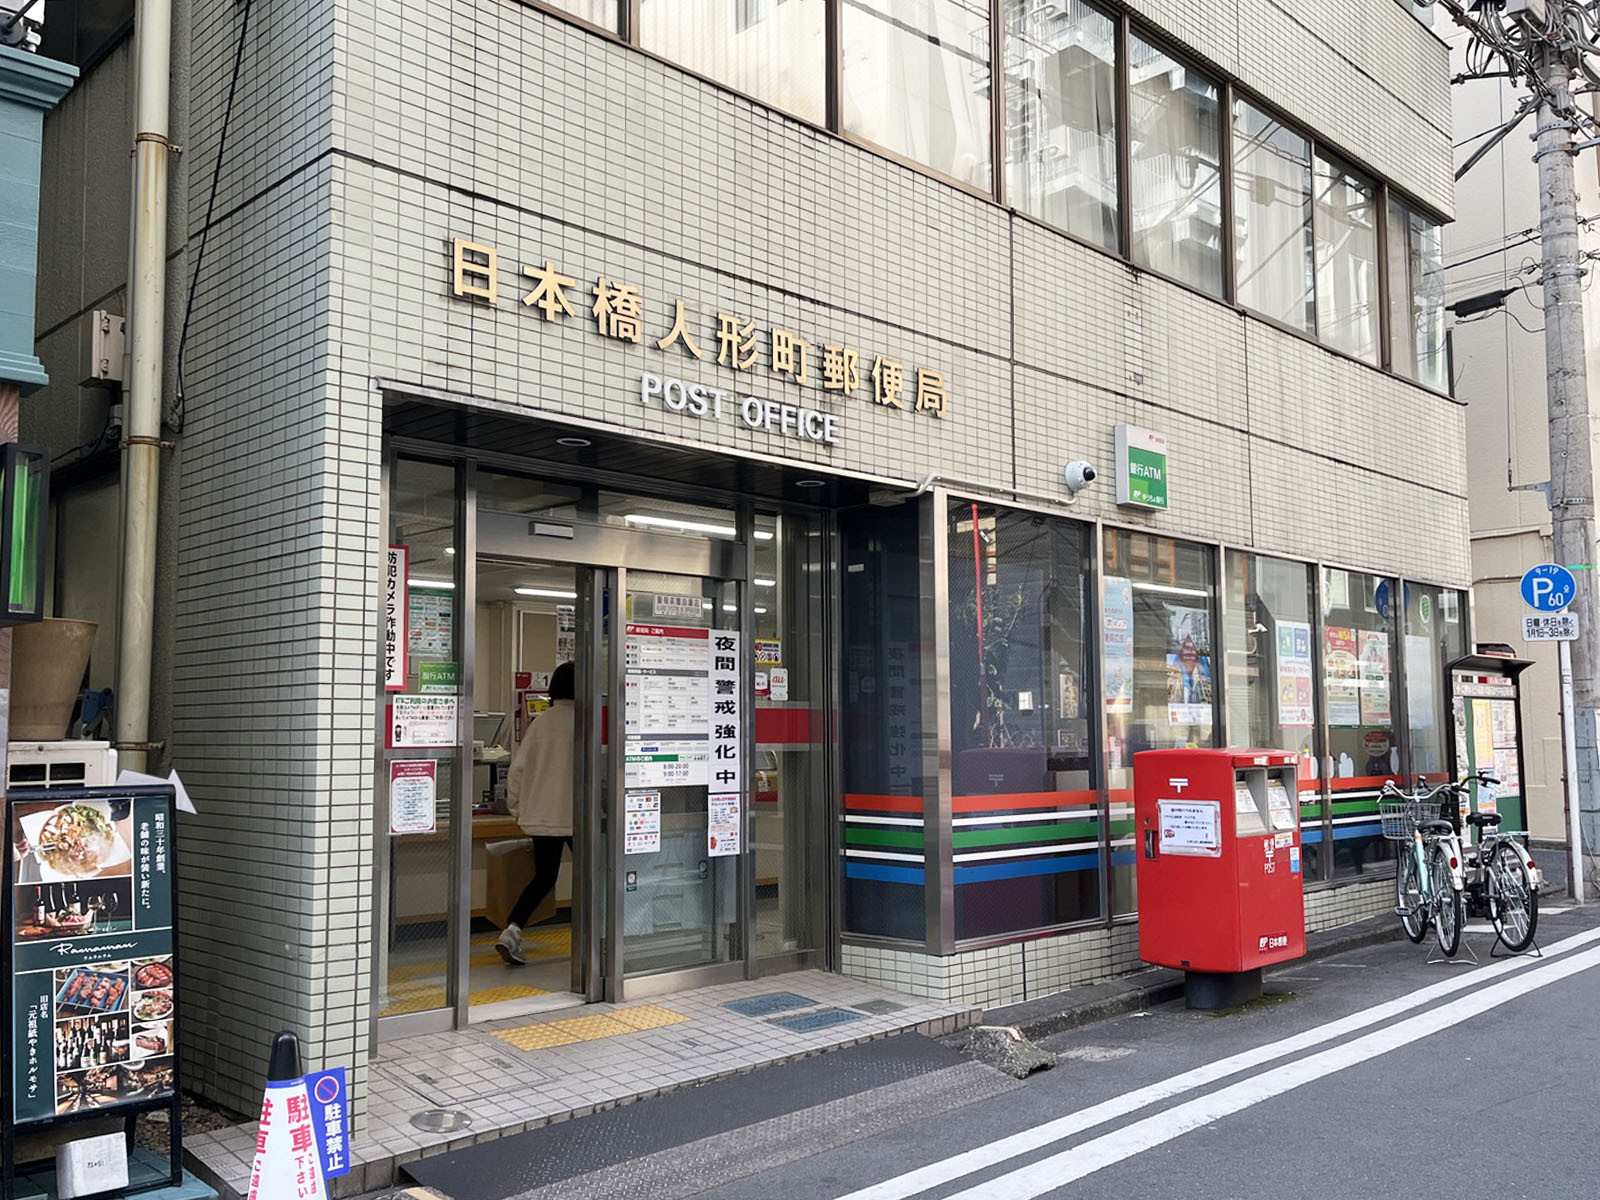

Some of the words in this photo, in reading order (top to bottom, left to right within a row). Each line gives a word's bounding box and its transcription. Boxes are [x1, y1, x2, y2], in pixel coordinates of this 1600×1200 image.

[453, 237, 949, 419] 日本橋人形町郵便局
[641, 372, 727, 419] POST
[742, 395, 840, 445] OFFICE
[1532, 577, 1554, 607] P
[1535, 566, 1559, 575] 9-19
[385, 552, 397, 681] 防犯カメラ作動中です
[714, 636, 736, 784] 夜間警戒強化中
[40, 994, 49, 1019] 旧店名
[323, 1102, 344, 1172] 駐車禁止
